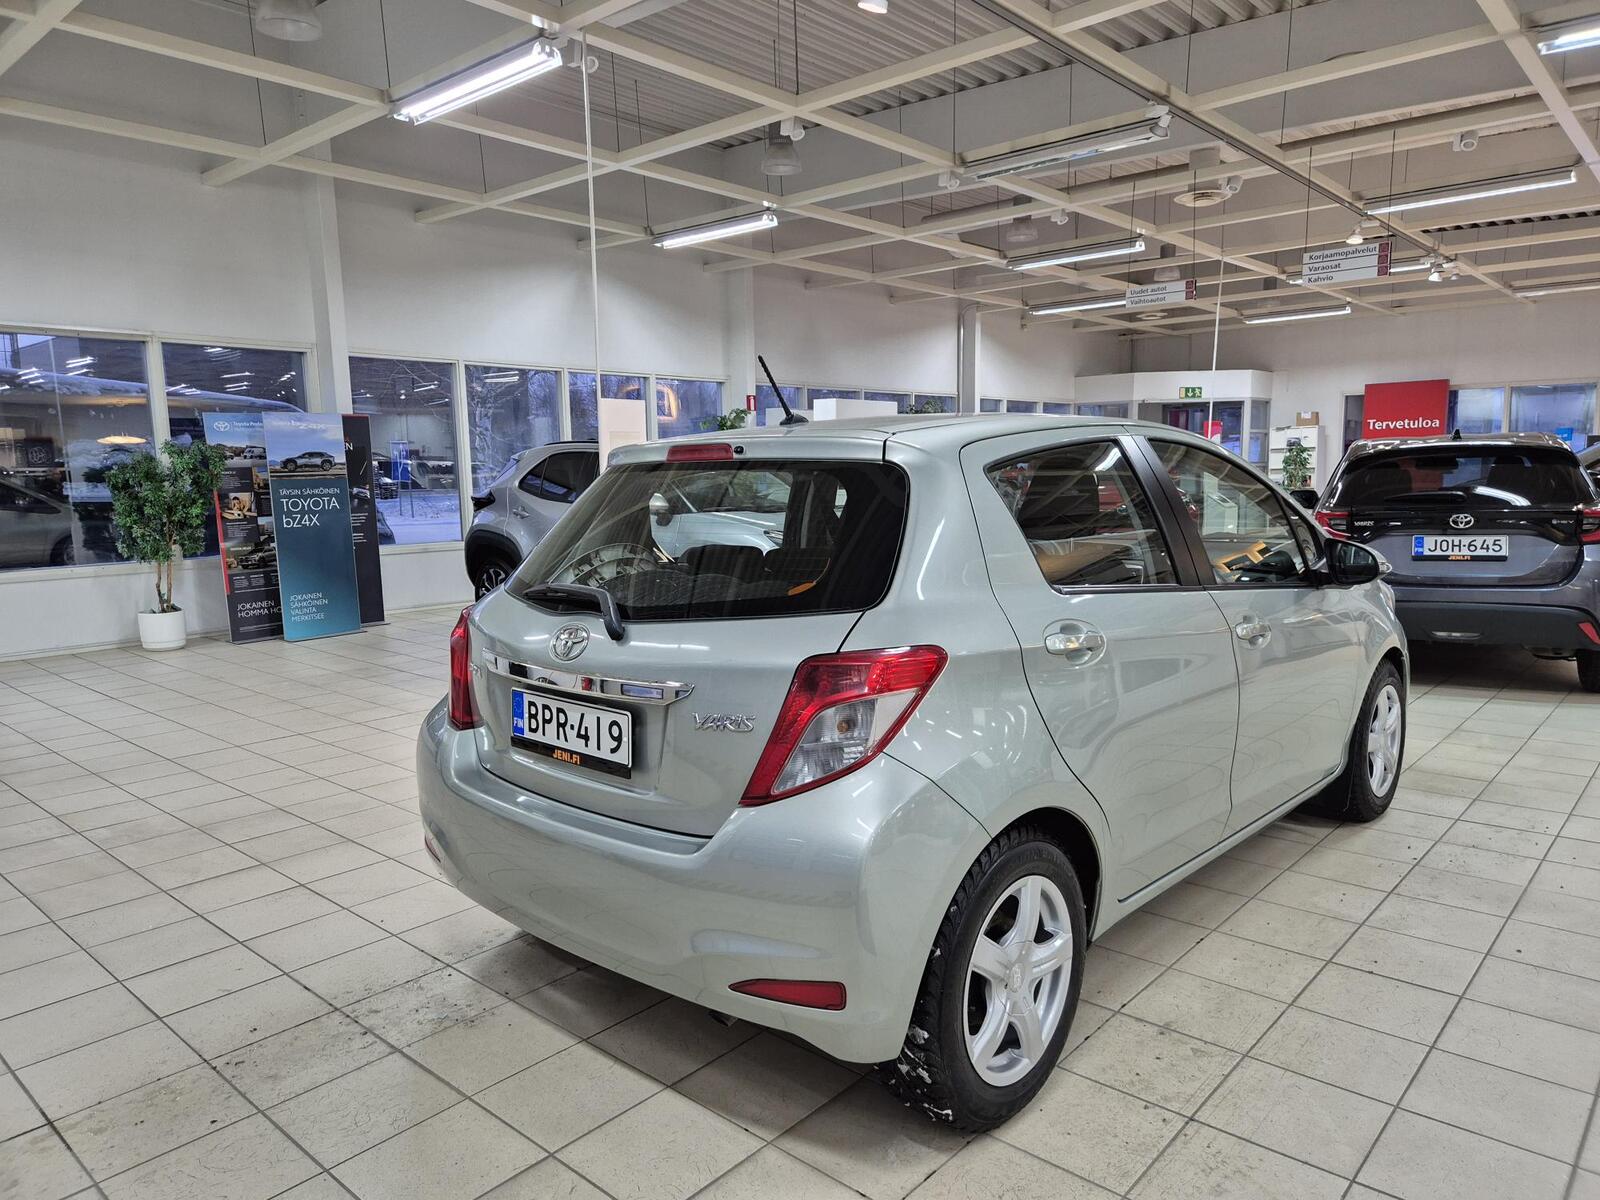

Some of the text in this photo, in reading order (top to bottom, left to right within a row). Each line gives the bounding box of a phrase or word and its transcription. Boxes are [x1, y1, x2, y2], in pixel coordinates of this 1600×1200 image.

[1309, 246, 1377, 261] Korjaamopalvelut
[1308, 263, 1341, 273] Varaosat
[1307, 275, 1334, 284] Kahvio
[1130, 285, 1168, 296] Uudet autot
[1130, 296, 1166, 305] Vaihtoautot
[1367, 416, 1440, 430] Tervetuloa
[279, 487, 340, 496] TÄYSIN SÄHKÖINEN
[280, 496, 340, 512] TOYOTA
[282, 513, 320, 528] bZ4X
[1427, 538, 1503, 553] JOH-645
[290, 592, 322, 601] JOKAINEN
[237, 600, 275, 611] JOKAINEN
[291, 598, 329, 609] SÄHKÖINEN
[238, 608, 269, 618] HOMMA
[291, 607, 317, 616] VALINTA
[291, 612, 325, 622] MERKITSEE
[513, 699, 624, 755] FIN BPR-419
[691, 711, 756, 733] YARIS
[552, 748, 581, 766] JENI.FI
